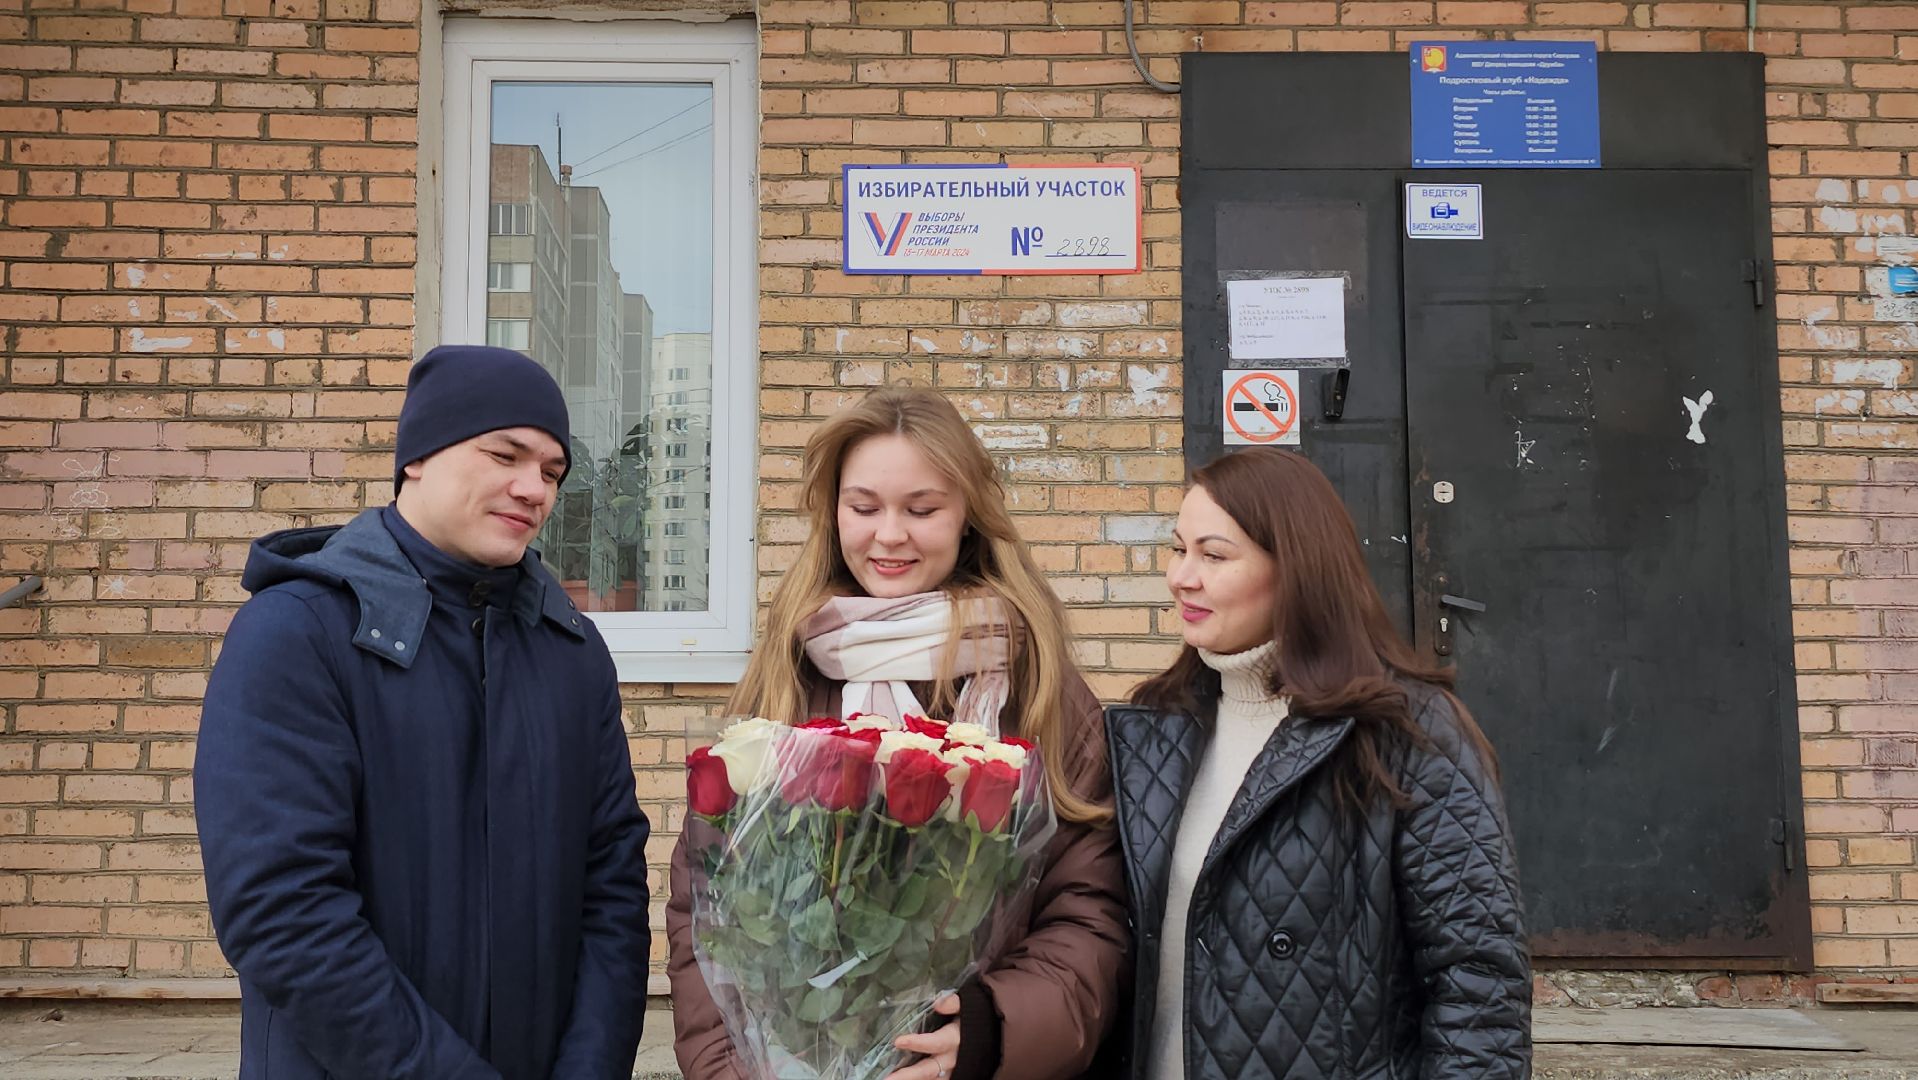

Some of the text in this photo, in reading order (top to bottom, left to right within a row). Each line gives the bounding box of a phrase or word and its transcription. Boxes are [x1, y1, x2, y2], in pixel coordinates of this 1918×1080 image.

[858, 177, 1126, 198] ИЗБИРАТЕЛЬНЫЙ УЧАСТОК
[1422, 189, 1468, 198] ВЕДЕТСЯ
[918, 212, 966, 222] ВЫБОРЫ
[912, 224, 979, 235] ПРЕЗИДЕНТА
[907, 236, 950, 246] РОССИИ
[1056, 236, 1110, 256] 2898
[925, 248, 950, 256] МАРТА
[952, 248, 970, 256] 2024
